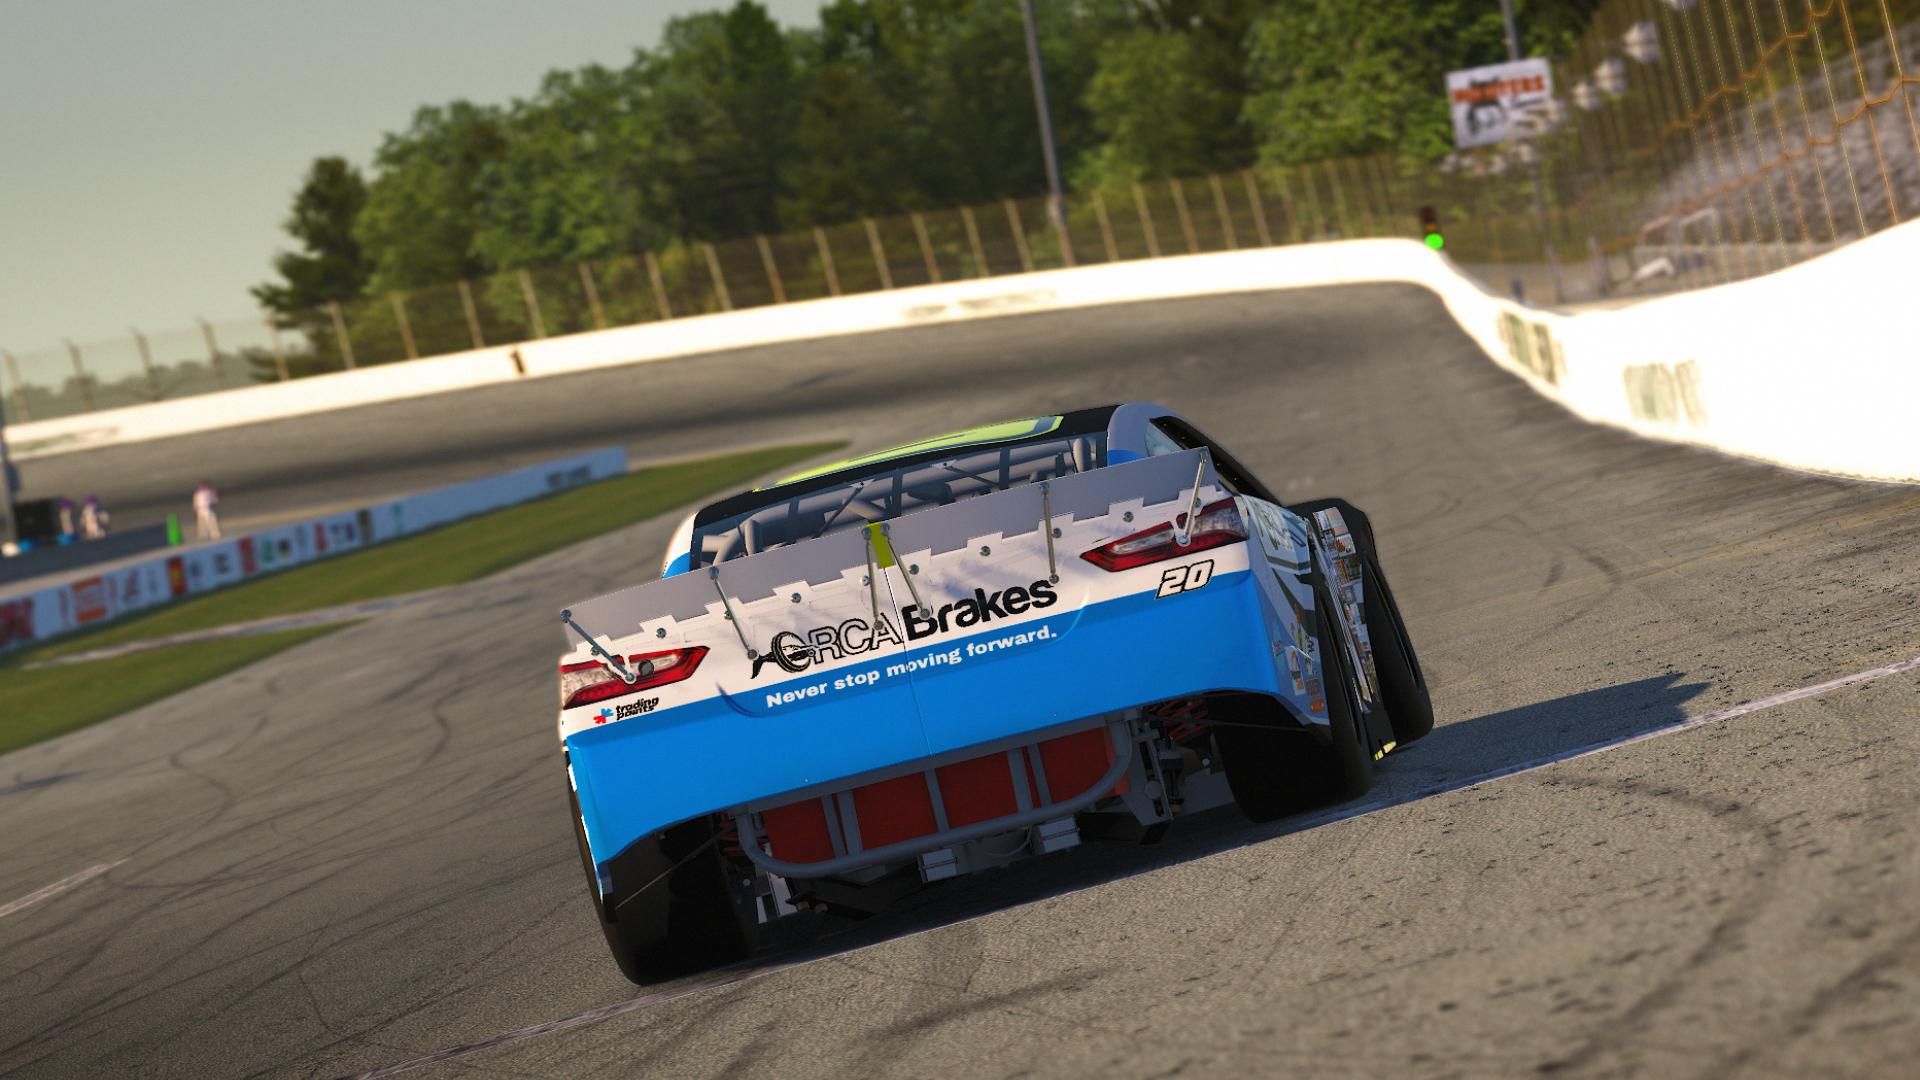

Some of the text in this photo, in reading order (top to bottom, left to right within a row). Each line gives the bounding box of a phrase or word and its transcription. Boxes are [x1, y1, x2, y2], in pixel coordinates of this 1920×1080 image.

[1156, 559, 1214, 599] 20
[901, 579, 1058, 641] Brakes
[766, 626, 1057, 708] Never stop moving forward.
[616, 697, 659, 713] trading
